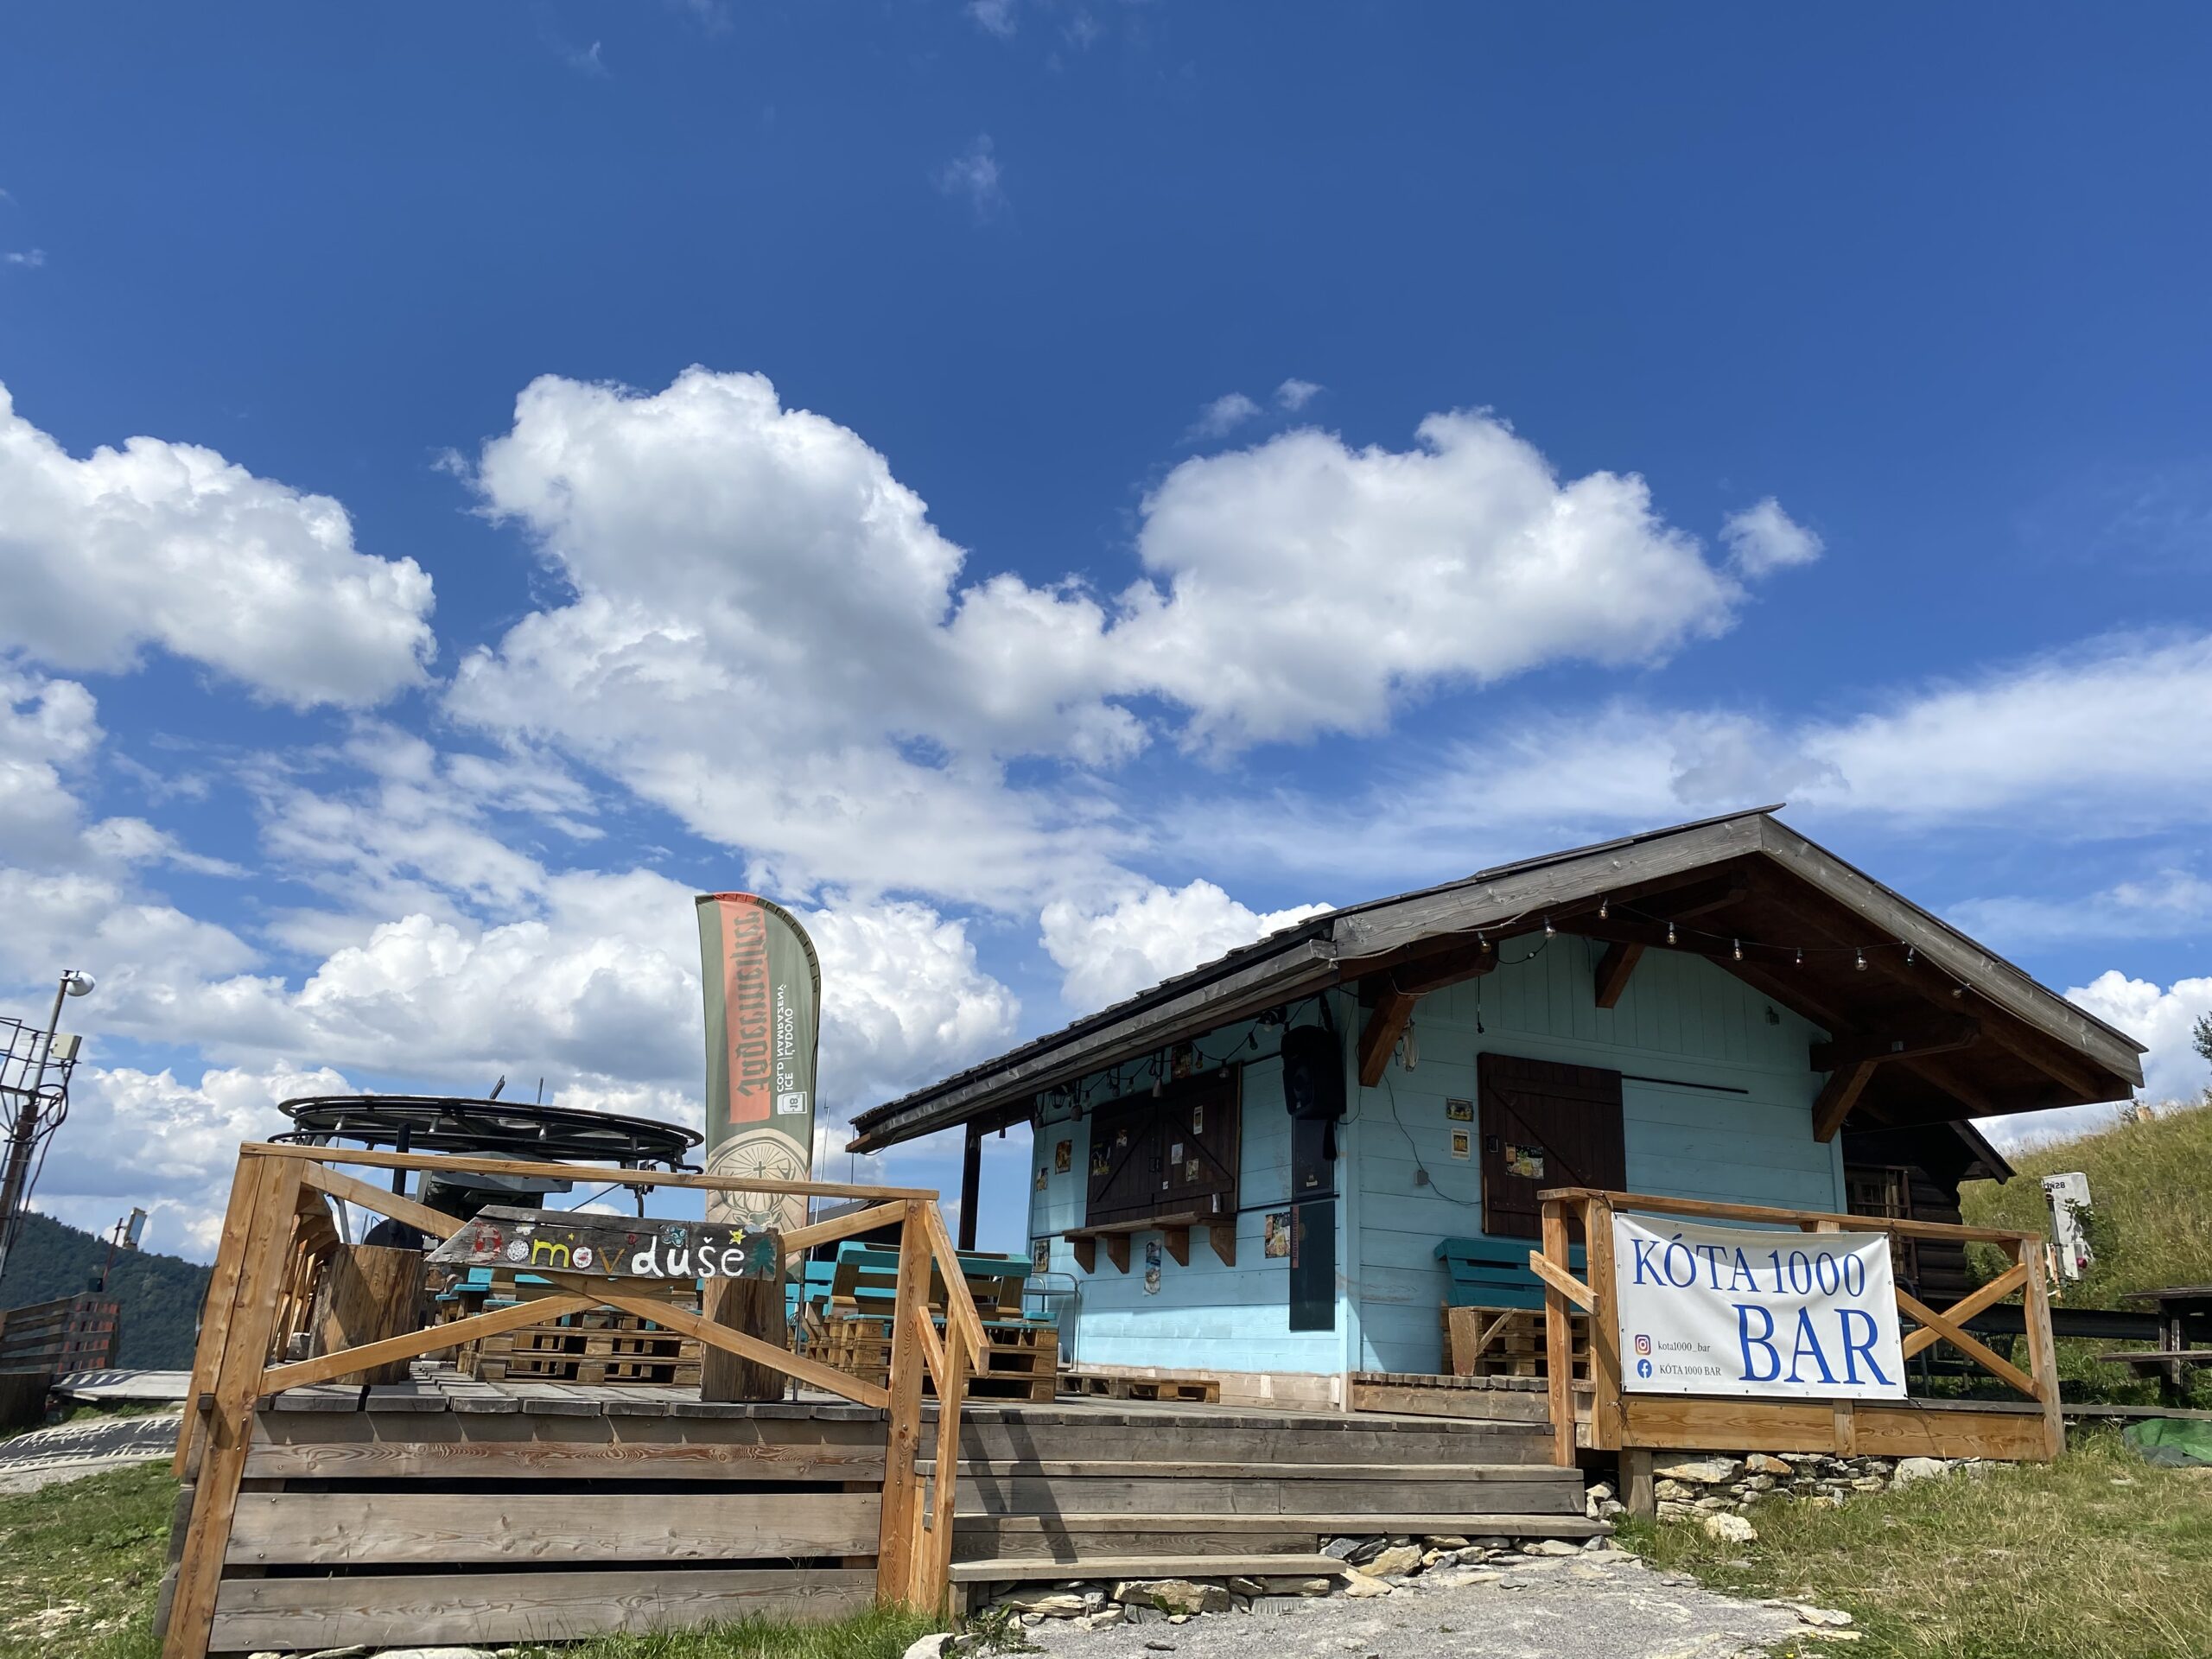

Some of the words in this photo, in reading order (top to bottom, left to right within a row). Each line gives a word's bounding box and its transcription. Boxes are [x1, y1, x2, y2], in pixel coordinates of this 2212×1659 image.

[632, 1235, 745, 1278] duše
[1630, 1233, 1762, 1293] KÓTA
[1768, 1249, 1866, 1297] 1000
[1657, 1340, 1711, 1354] kota1000_bar
[1732, 1304, 1896, 1386] BAR
[1659, 1363, 1682, 1376] KÓTA
[1684, 1365, 1702, 1376] 1000
[1704, 1366, 1721, 1376] BAR
